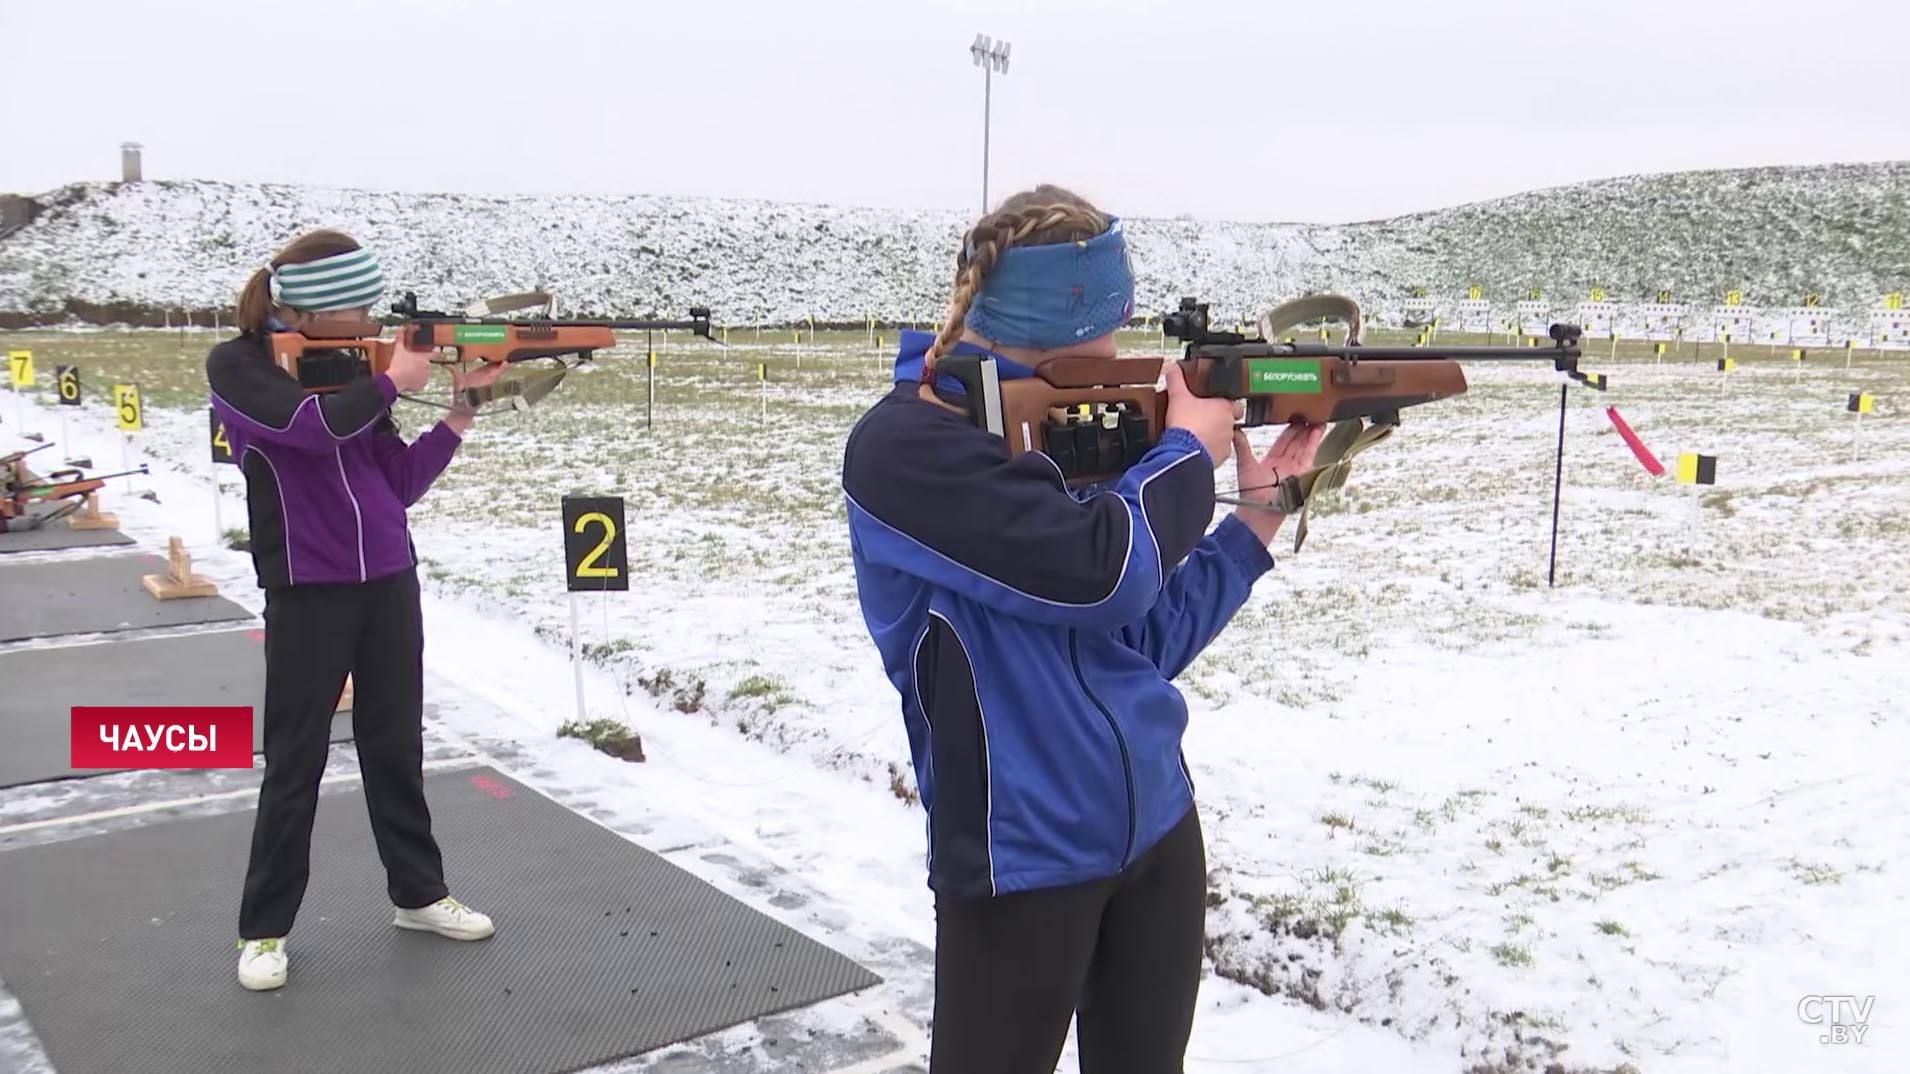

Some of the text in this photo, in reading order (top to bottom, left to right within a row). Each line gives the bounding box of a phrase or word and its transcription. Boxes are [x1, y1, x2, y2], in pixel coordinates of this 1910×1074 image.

[1728, 292, 1741, 305] 13
[13, 356, 28, 381] 7
[60, 365, 78, 400] 6
[121, 391, 137, 424] 5
[214, 422, 232, 457] 4
[574, 511, 619, 577] 2
